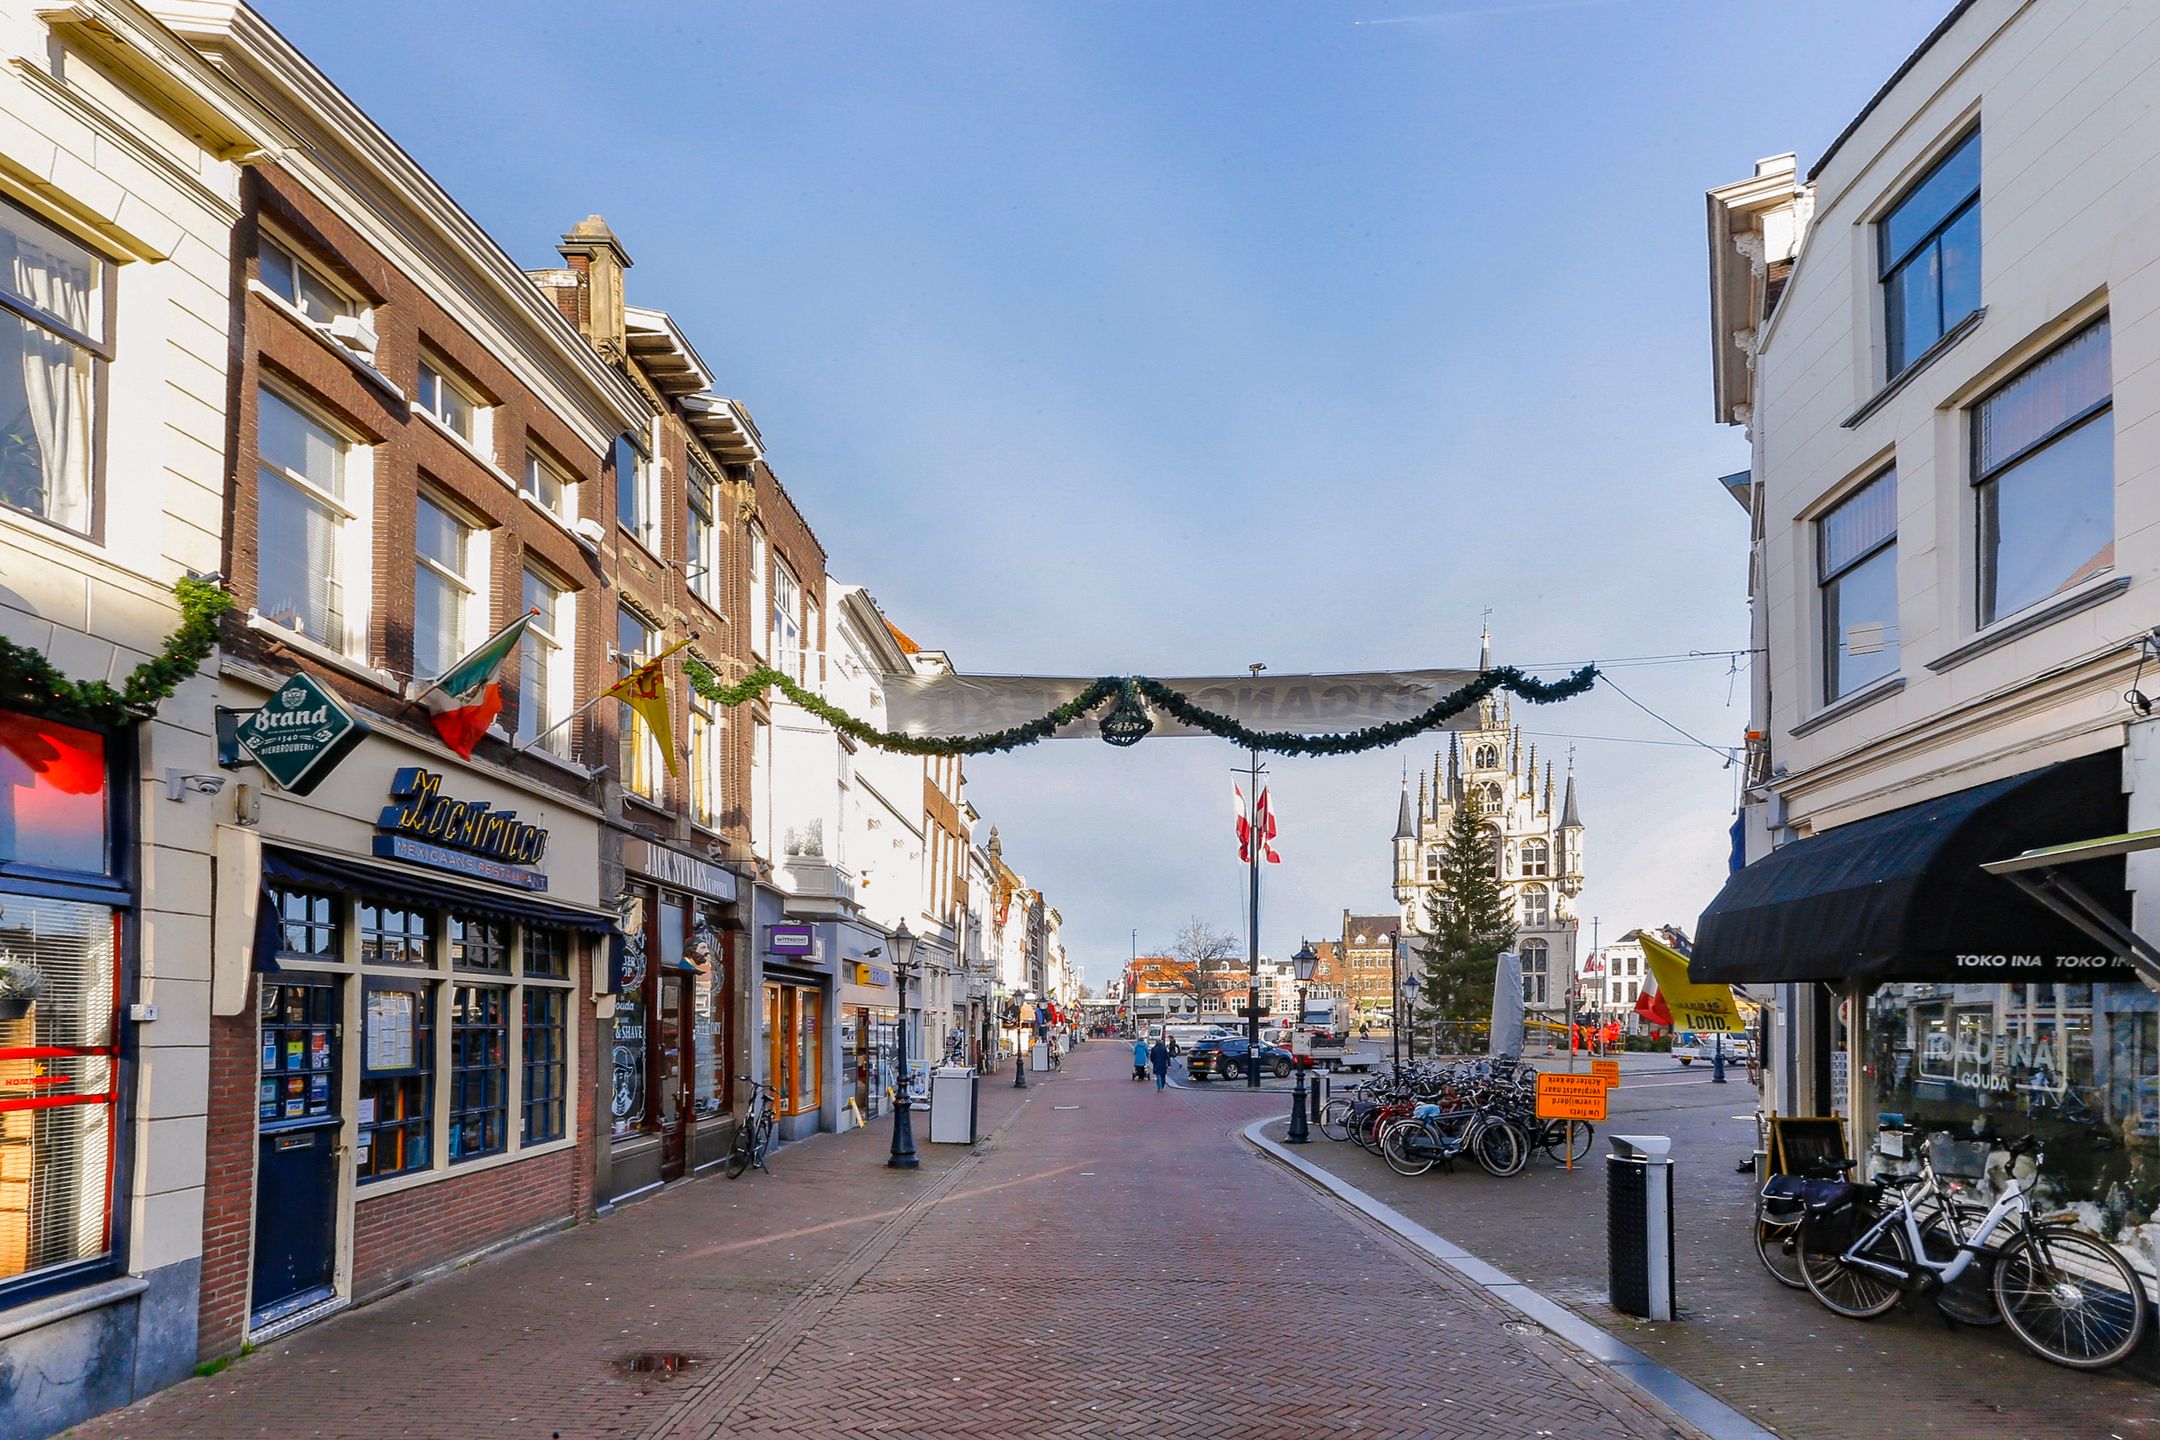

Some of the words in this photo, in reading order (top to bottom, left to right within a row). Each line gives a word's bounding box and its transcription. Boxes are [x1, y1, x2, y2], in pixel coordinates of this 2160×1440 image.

[255, 705, 328, 732] Brand
[261, 743, 314, 755] BIERBROUWERIJ
[397, 841, 474, 870] MEXICAANS
[479, 862, 546, 889] RESTAURANT
[645, 842, 672, 881] JACK
[673, 852, 708, 892] STYLES
[1956, 954, 2006, 967] TOKO
[2011, 955, 2042, 967] INA
[2055, 956, 2107, 968] TOKO
[2111, 956, 2135, 968] IN
[615, 1000, 635, 1010] ouda
[1927, 1033, 1992, 1064] TOKO
[1998, 1036, 2055, 1070] INA
[1547, 1076, 1565, 1084] kerk
[1565, 1077, 1575, 1085] de
[1576, 1078, 1601, 1086] Achter
[1961, 1072, 2010, 1092] GOUDA
[1563, 1087, 1601, 1095] verplaatst
[1551, 1096, 1592, 1106] verwijderd
[1569, 1108, 1587, 1117] fiets
